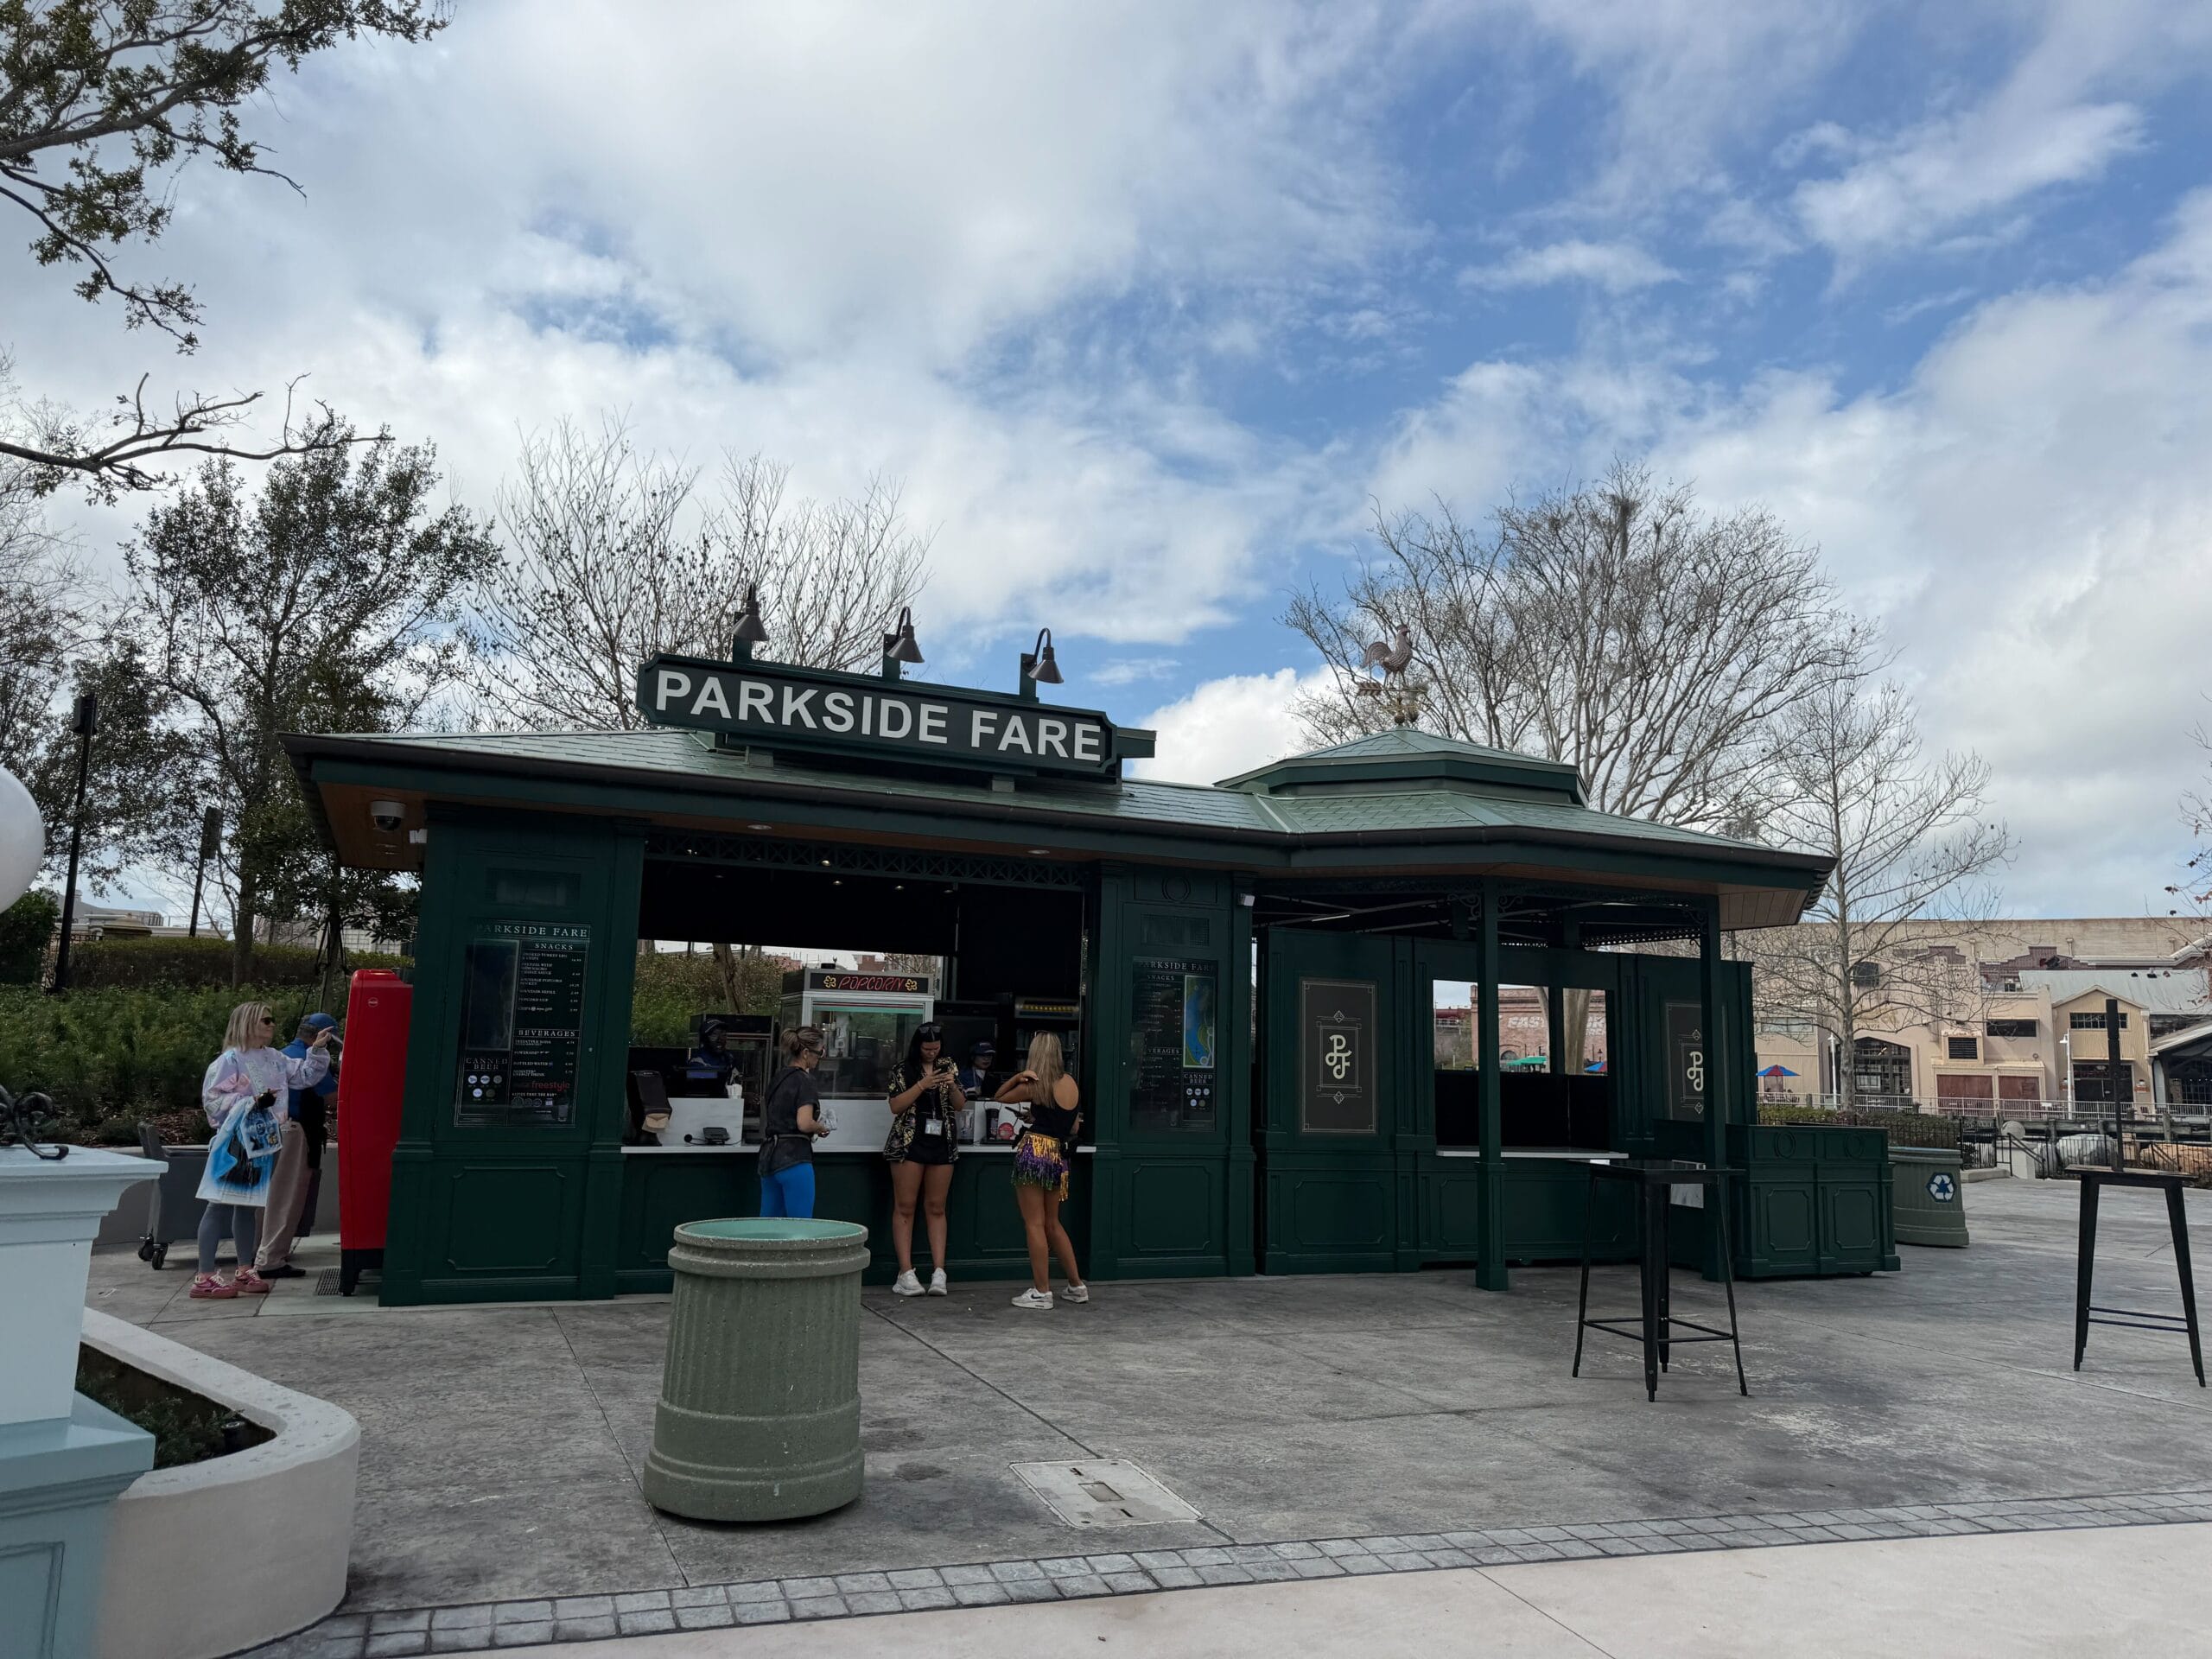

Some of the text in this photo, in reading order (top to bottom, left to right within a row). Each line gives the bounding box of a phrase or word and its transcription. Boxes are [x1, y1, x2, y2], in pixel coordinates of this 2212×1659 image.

[657, 670, 1101, 762] PARKSIDE FARE
[552, 927, 588, 938] FARE
[534, 942, 574, 950] SNACKS
[837, 976, 906, 992] POPCORN
[531, 1080, 570, 1092] freestyle
